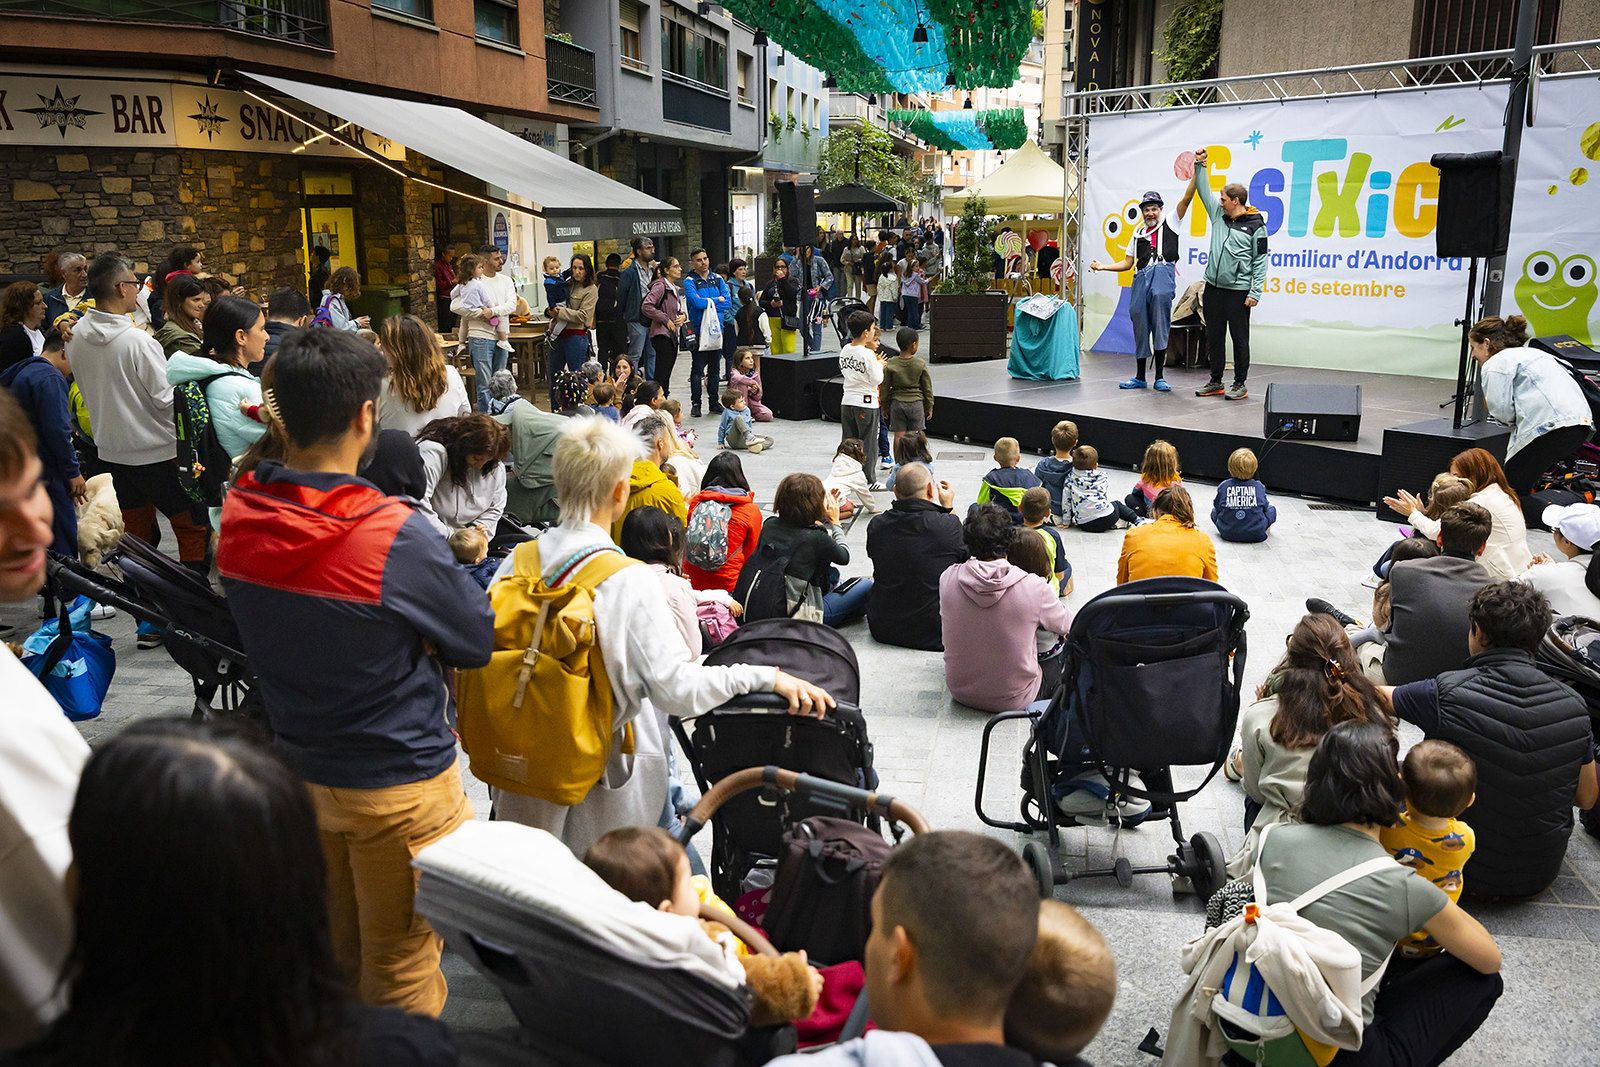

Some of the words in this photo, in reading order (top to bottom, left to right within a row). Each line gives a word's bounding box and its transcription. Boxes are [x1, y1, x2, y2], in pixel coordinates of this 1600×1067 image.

[1089, 9, 1101, 62] NOVA
[110, 94, 166, 134] BAR
[240, 103, 320, 144] SNACK
[657, 221, 667, 233] LAS
[667, 221, 682, 233] VEGAS
[1285, 277, 1307, 294] de
[1311, 280, 1406, 298] setembre
[1225, 496, 1258, 507] AMERICA
[1226, 486, 1256, 496] CAPTAIN
